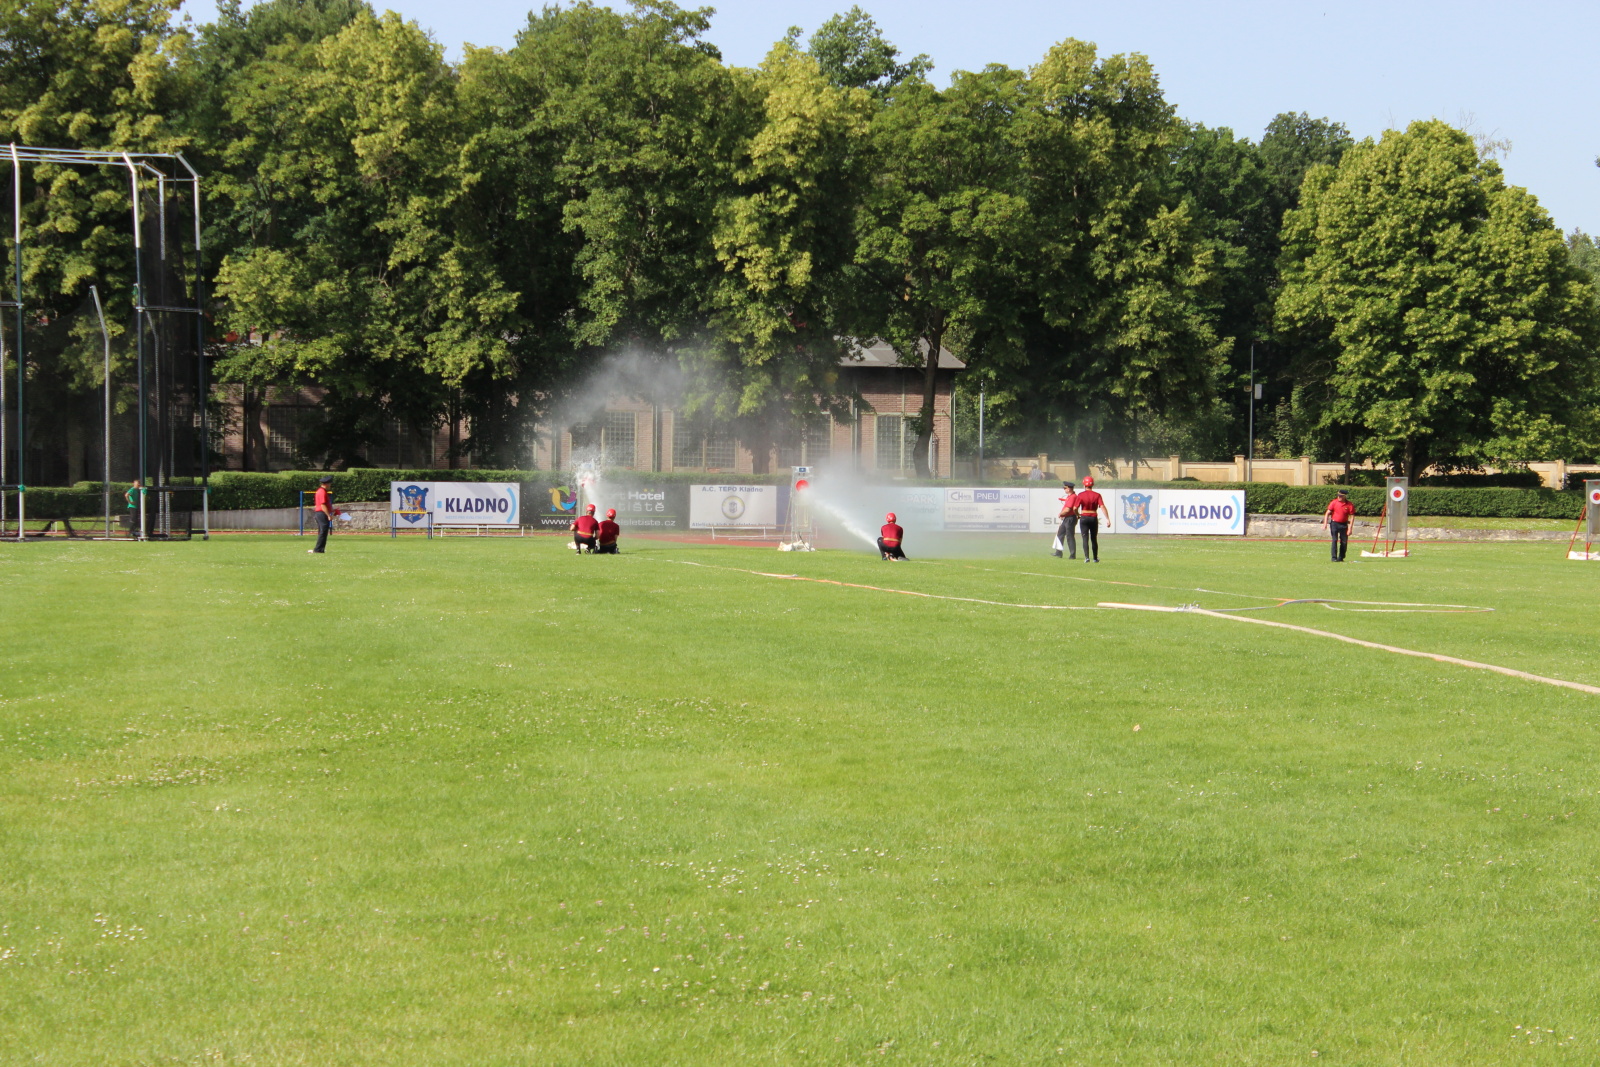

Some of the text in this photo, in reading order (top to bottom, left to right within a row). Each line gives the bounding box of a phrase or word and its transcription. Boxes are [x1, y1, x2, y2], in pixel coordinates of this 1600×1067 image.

[628, 491, 665, 500] Hotel
[976, 492, 999, 500] PNEU
[445, 497, 509, 513] KLADNO
[1169, 505, 1233, 520] KLADNO
